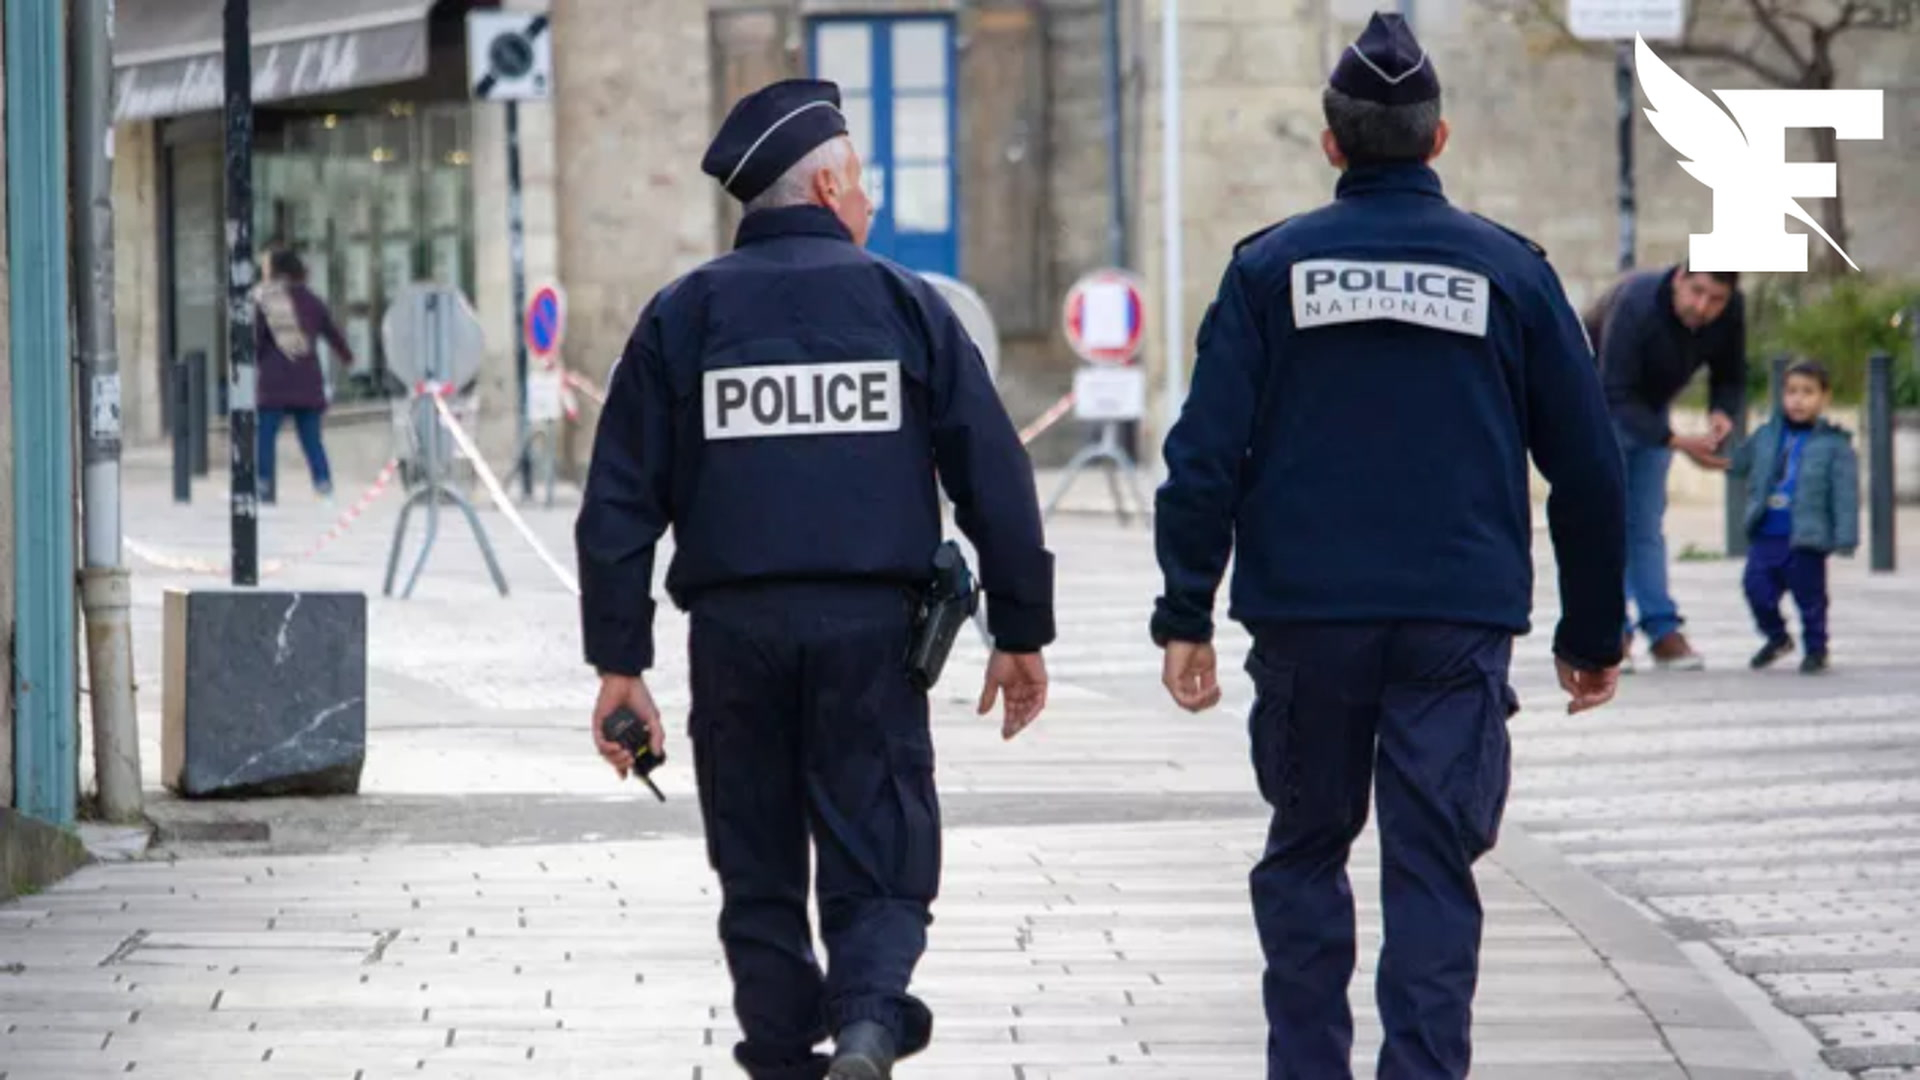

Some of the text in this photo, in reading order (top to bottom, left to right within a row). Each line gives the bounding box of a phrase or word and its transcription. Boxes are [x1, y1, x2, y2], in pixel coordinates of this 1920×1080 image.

[1305, 268, 1476, 304] POLICE
[1305, 297, 1474, 325] NATIONALE
[716, 371, 889, 428] POLICE
